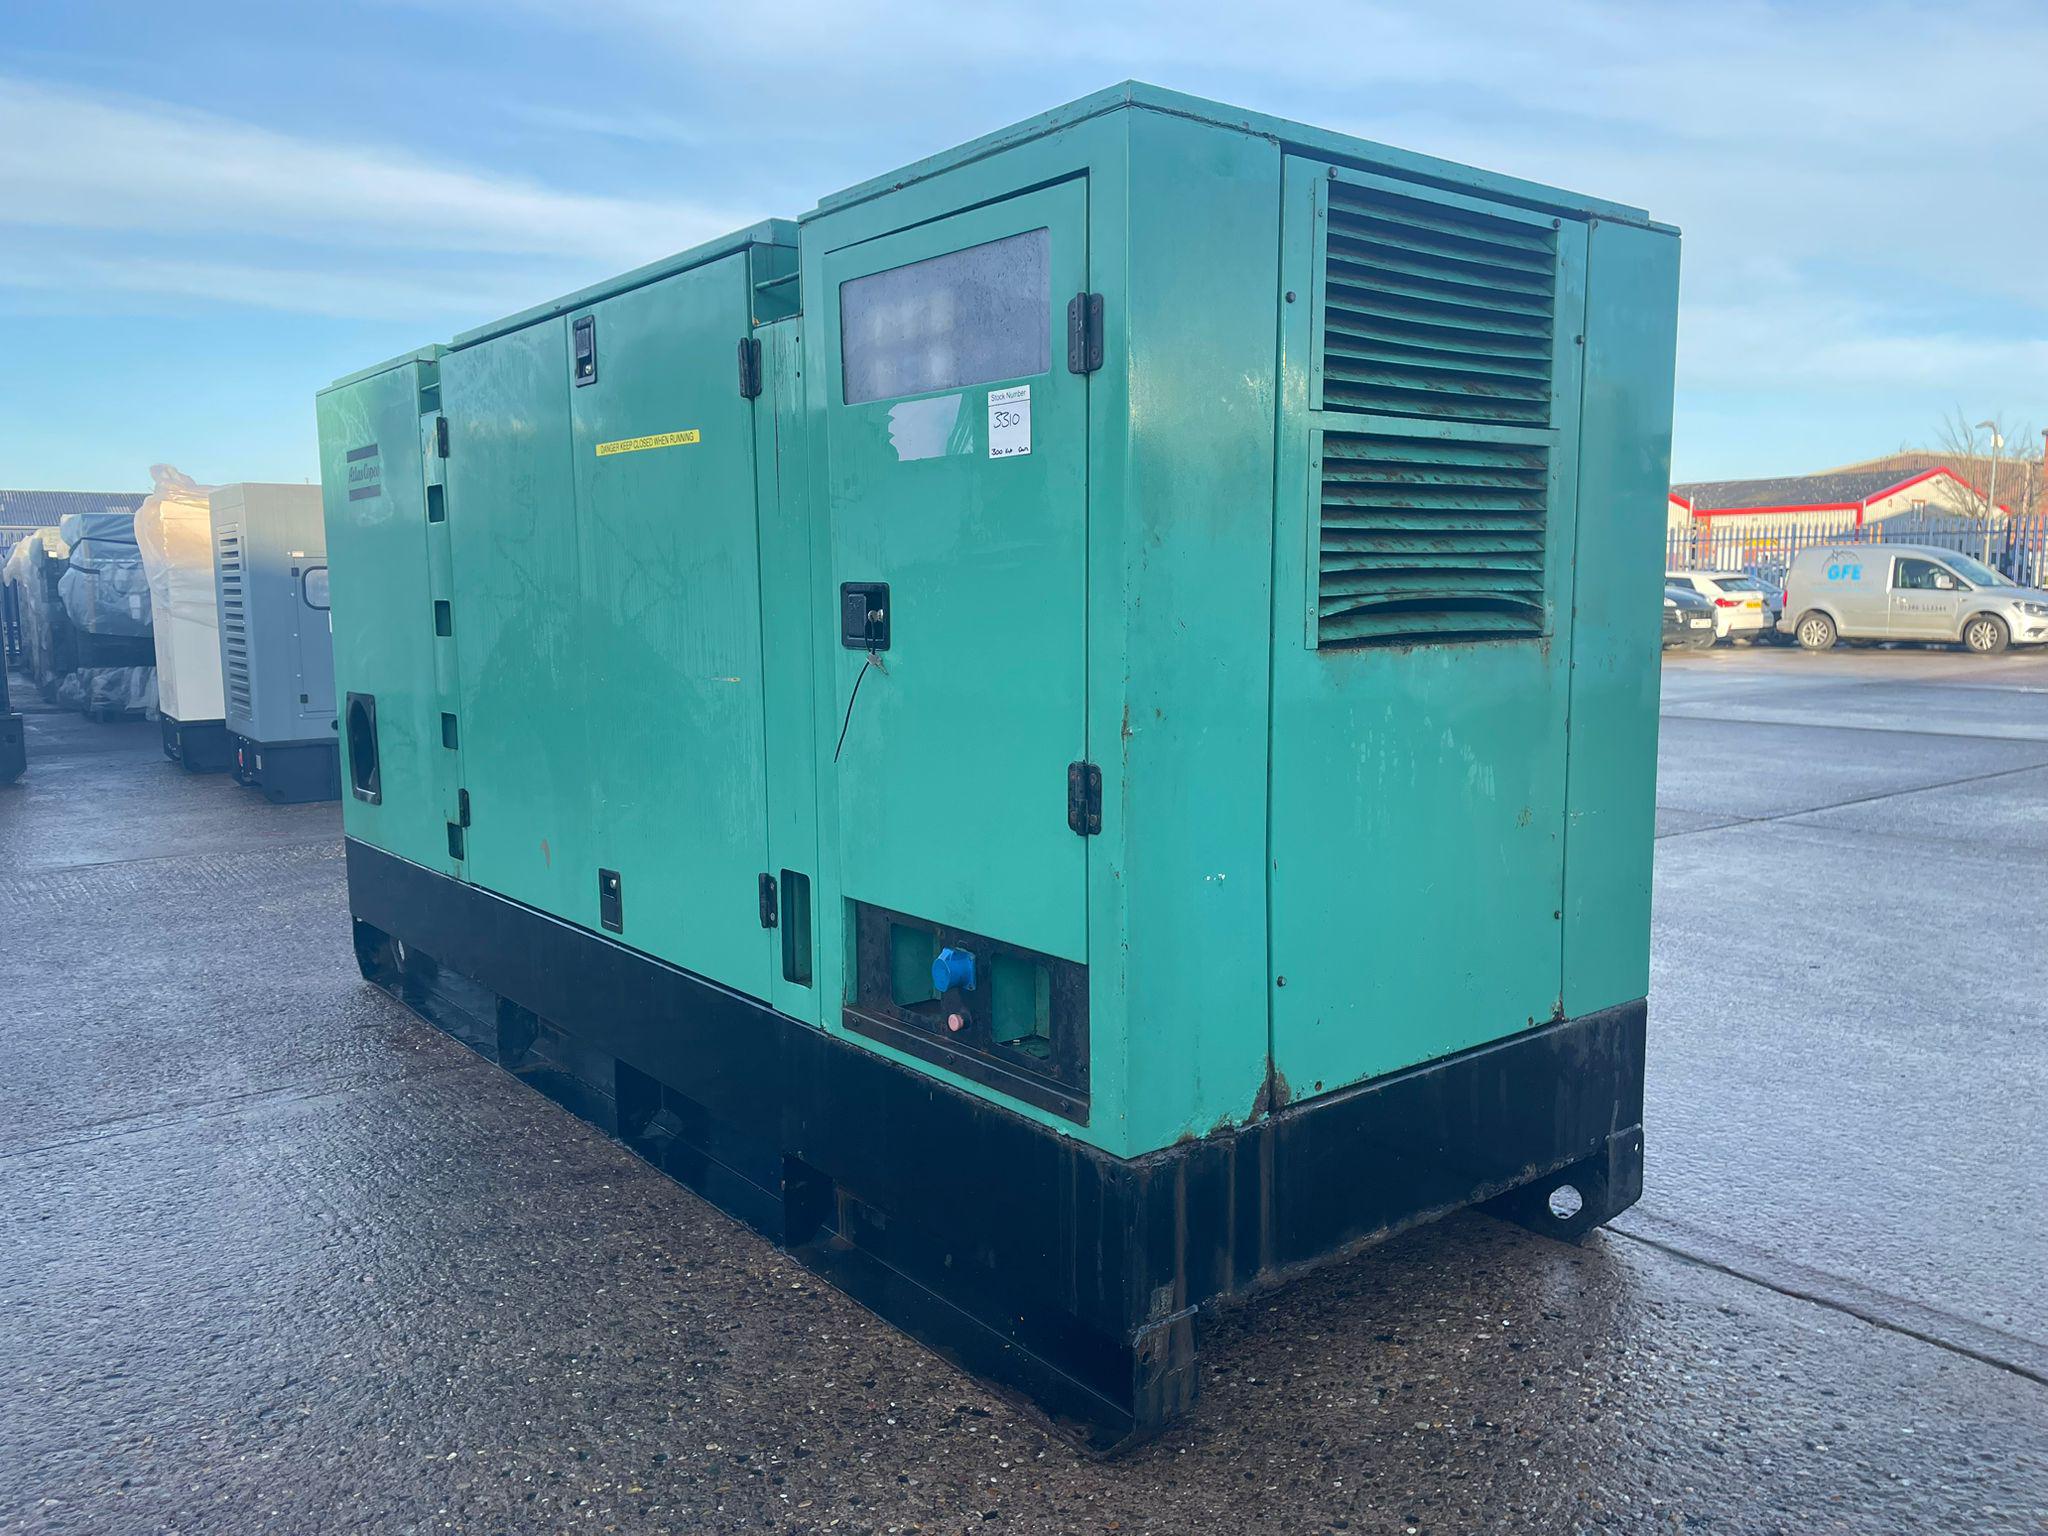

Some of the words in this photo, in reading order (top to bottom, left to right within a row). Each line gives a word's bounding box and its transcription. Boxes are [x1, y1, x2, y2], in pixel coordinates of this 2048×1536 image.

[990, 393, 1005, 402] Stock
[1006, 390, 1026, 399] Number
[993, 411, 1020, 429] 3310
[600, 443, 619, 454] DANGER
[620, 440, 632, 451] KEEP
[634, 437, 653, 449] CLOSED
[654, 435, 669, 446] WHEN
[670, 431, 694, 444] RUNNING
[991, 448, 1003, 456] 300
[1827, 564, 1863, 581] GFE
